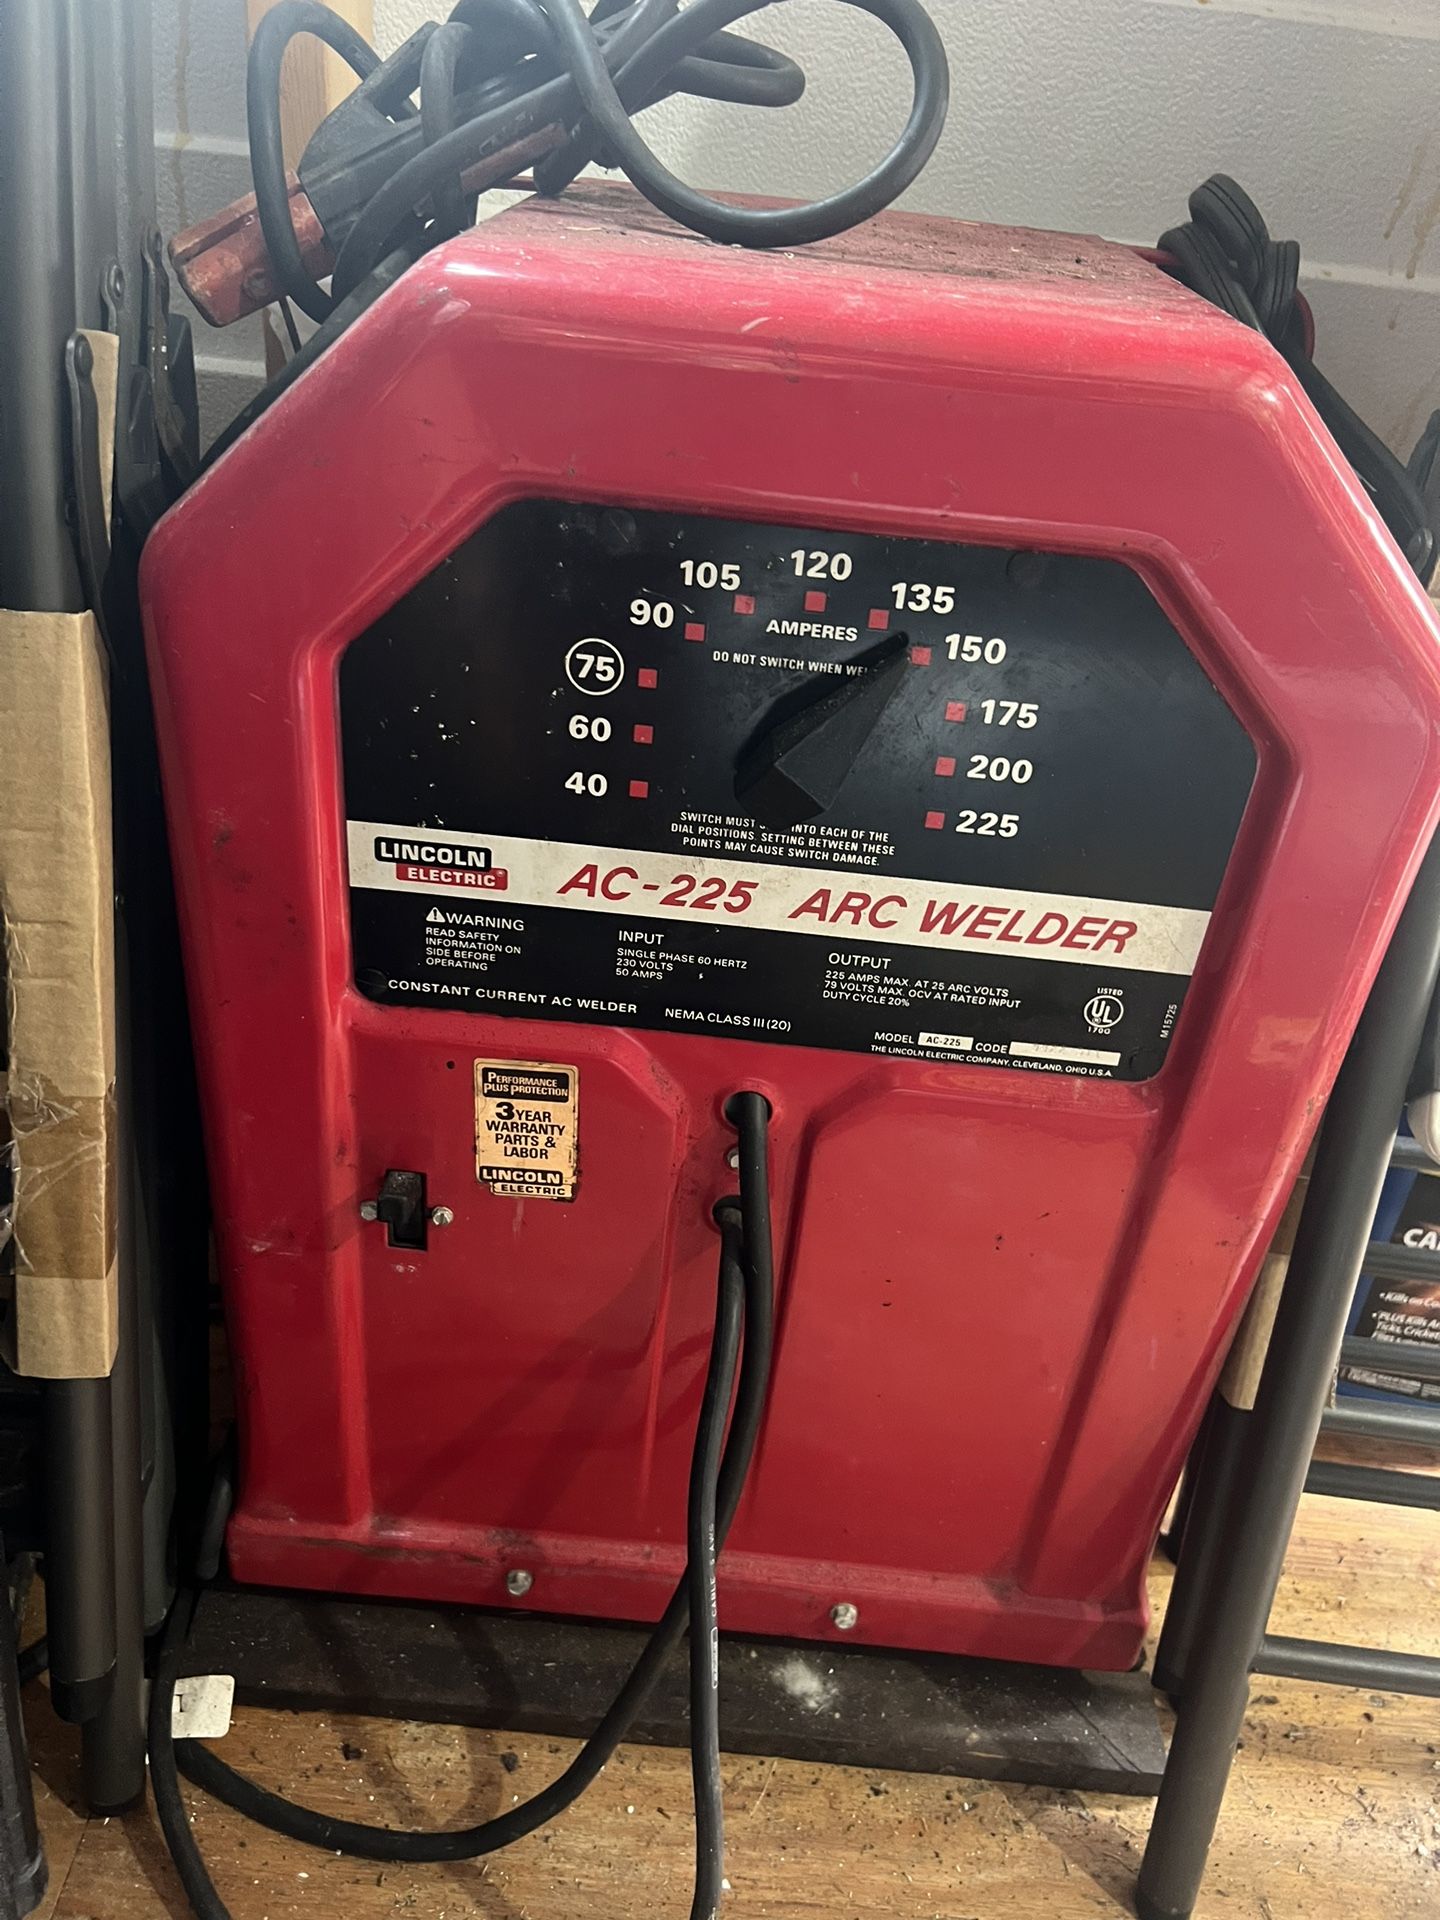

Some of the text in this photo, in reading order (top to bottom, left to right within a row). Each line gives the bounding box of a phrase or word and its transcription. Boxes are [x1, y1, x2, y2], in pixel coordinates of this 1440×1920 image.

[680, 560, 741, 592] 105
[790, 549, 853, 581] 120
[891, 582, 955, 615] 135
[629, 599, 674, 628] 90
[766, 619, 858, 642] AMPERES
[944, 633, 1007, 664] 150
[575, 654, 616, 682] 75
[713, 650, 729, 662] DO
[733, 652, 756, 665] NOT
[760, 655, 804, 671] SWITCH
[808, 661, 842, 675] WHEN
[980, 699, 1039, 729] 175
[568, 715, 612, 742] 60
[966, 754, 1034, 785] 200
[564, 771, 608, 797] 40
[680, 811, 722, 825] SWITCH
[725, 816, 756, 828] MUST
[791, 823, 817, 835] INTO
[820, 826, 848, 838] EACH
[851, 830, 866, 840] OF
[869, 831, 889, 843] THE
[955, 809, 1020, 838] 225
[671, 823, 694, 834] DIAL
[761, 832, 805, 846] SETTING
[808, 838, 859, 852] BETWEEN
[862, 843, 895, 856] THESE
[380, 841, 485, 868] LINCOLN
[683, 837, 880, 866] POINTS MAY CAUSE SWITCH DAMAGE.
[407, 867, 496, 887] ELECTRIC
[557, 863, 1138, 954] AC-225 ARC WELDER
[446, 912, 525, 931] WARNING
[426, 927, 500, 942] READ SAFETY
[426, 937, 522, 954] INFORMATION ON
[618, 930, 664, 945] INPUT
[426, 947, 496, 962] SIDE BEFORE
[426, 957, 488, 971] OPERATING
[616, 957, 674, 971] 230 VOLTS
[617, 947, 748, 970] SINGLE PHASE 60 HERTZ
[828, 952, 891, 969] OUTPUT
[615, 968, 663, 980] 50 AMPS
[825, 970, 845, 980] 225
[848, 972, 880, 984] AMPS
[914, 980, 929, 988] AT
[932, 981, 945, 990] 25
[948, 983, 971, 994] ARC
[974, 986, 1009, 998] VOLTS
[388, 979, 637, 1014] CONSTANT CURRENT AC WELDER
[823, 990, 910, 1007] DUTY CYCLE 20%
[824, 980, 837, 989] 79
[840, 982, 875, 993] VOLTS
[908, 989, 932, 999] OCV
[934, 992, 949, 1001] AT
[950, 993, 986, 1006] RATED
[988, 998, 1021, 1008] INPUT
[1097, 987, 1123, 996] LISTED
[665, 1008, 704, 1021] NEMA
[707, 1012, 750, 1026] CLASS
[1091, 999, 1113, 1023] UL
[1160, 1004, 1178, 1039] M15725
[874, 1031, 1008, 1054] MODEL AC-225 CODE
[870, 1044, 887, 1053] THE
[888, 1046, 924, 1057] LINCOLN
[926, 1050, 964, 1061] ELECTRIC
[1065, 1065, 1087, 1074] OHIO
[484, 1083, 568, 1097] PLUS PROTECTION
[487, 1071, 558, 1088] PERFORMANCE
[495, 1101, 552, 1123] 3 YEAR
[486, 1120, 566, 1136] WARRANTY
[495, 1134, 556, 1148] PARTS &
[504, 1147, 549, 1160] LABOR
[482, 1168, 560, 1184] LINCOLN
[501, 1184, 566, 1196] ELECTRIC
[709, 1577, 718, 1618] CABLE
